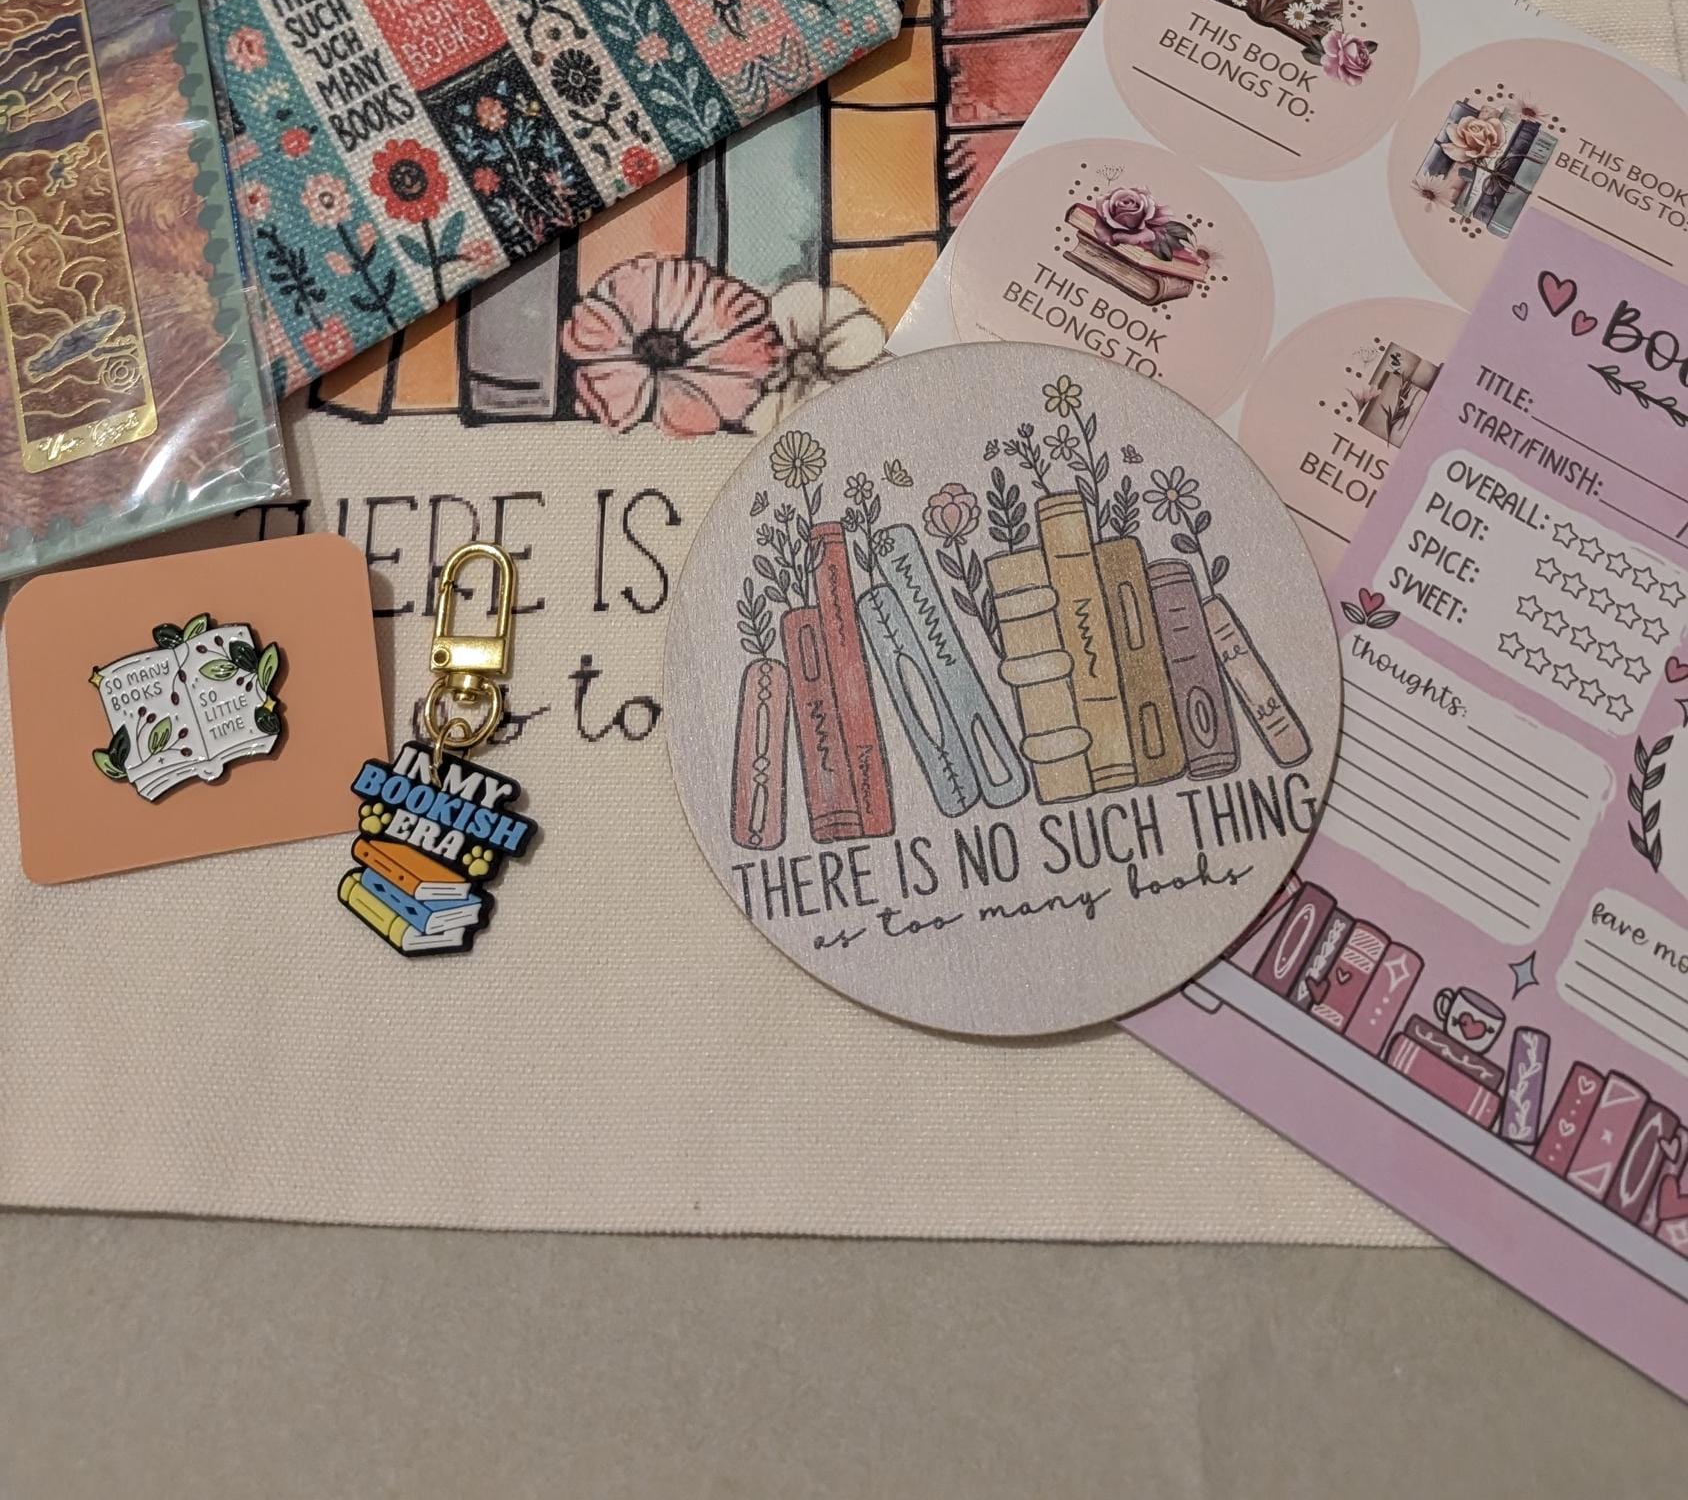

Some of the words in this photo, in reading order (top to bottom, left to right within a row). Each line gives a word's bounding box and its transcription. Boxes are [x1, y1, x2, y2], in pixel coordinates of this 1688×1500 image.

[401, 6, 489, 76] BOOKS
[1188, 11, 1242, 51] THIS
[1243, 43, 1317, 93] BOOK
[316, 48, 389, 110] MANY
[1158, 28, 1273, 98] BELONGS
[1276, 87, 1315, 122] TO:
[328, 83, 415, 152] BOOKS
[1555, 152, 1654, 211] BELONGS
[1578, 137, 1624, 173] THIS
[1626, 165, 1688, 208] BOOK
[1002, 281, 1121, 359] BELONGS
[1033, 262, 1090, 307] THIS
[1089, 297, 1168, 354] BOOK
[1474, 364, 1535, 413] TITLE:
[1331, 431, 1390, 481] THIS
[1458, 401, 1605, 498] START/FINISH:
[1425, 491, 1490, 541] PLOT:
[1446, 459, 1550, 530] OVERALL:
[593, 488, 682, 615] IS
[1408, 529, 1481, 584] SPICE:
[1388, 565, 1468, 625] SWEET:
[104, 677, 122, 696] SO
[127, 660, 171, 685] MANY
[111, 682, 162, 712] BOOKS
[200, 690, 218, 708] SO
[1351, 633, 1468, 719] thoughts:
[204, 695, 249, 722] LITTLE
[209, 717, 245, 740] TIME
[354, 762, 529, 851] BOOKISH
[442, 763, 513, 809] MY
[384, 808, 466, 861] ERA
[731, 844, 879, 921] THERE
[894, 836, 939, 899] IS
[954, 821, 1021, 890] NO
[1039, 794, 1164, 874] SUCH
[1176, 772, 1319, 850] THING
[813, 927, 867, 950] as
[877, 907, 964, 937] too
[979, 888, 1112, 920] many
[1127, 852, 1254, 900] books
[1591, 902, 1649, 946] fave
